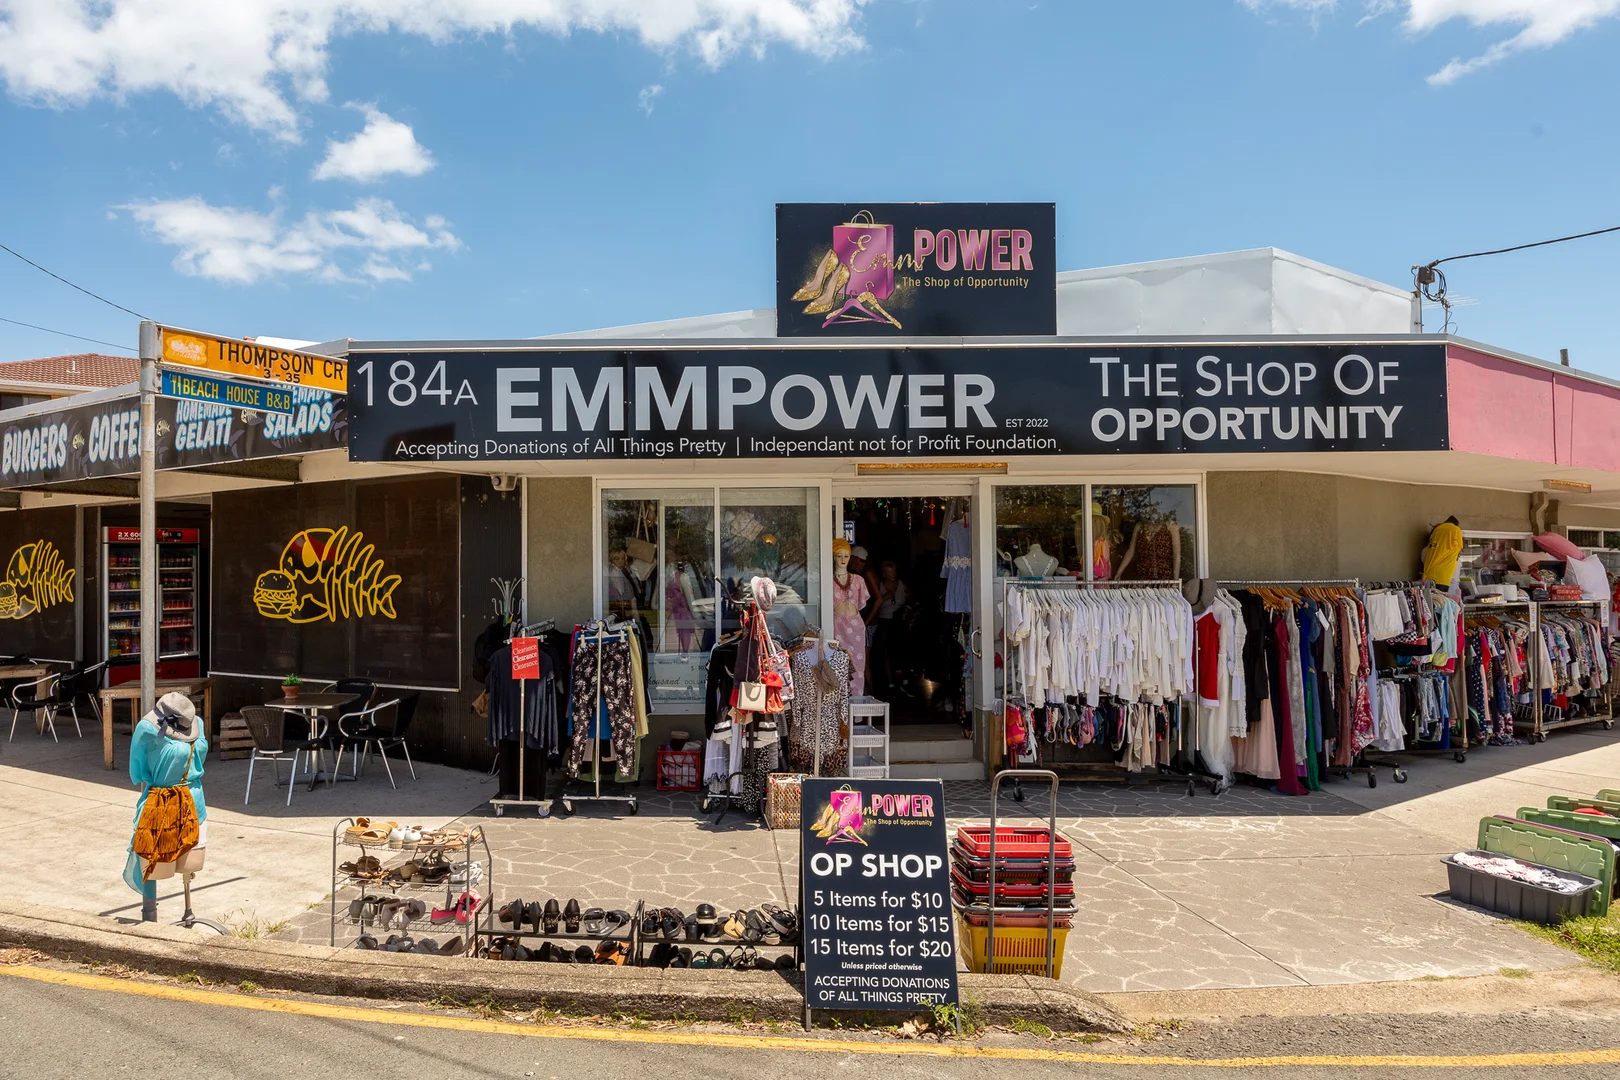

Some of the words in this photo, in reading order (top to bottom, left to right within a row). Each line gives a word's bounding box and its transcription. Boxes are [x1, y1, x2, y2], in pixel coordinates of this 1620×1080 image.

[913, 229, 1033, 271] POWER
[902, 276, 920, 287] The
[924, 276, 950, 289] Shop
[953, 276, 964, 287] of
[967, 276, 1029, 289] Opportunity
[216, 340, 314, 375] THOMPSON
[322, 359, 344, 382] CR
[264, 369, 271, 379] 3
[286, 372, 300, 384] 35
[183, 378, 219, 400] BEACH
[226, 385, 261, 406] HOUSE
[267, 391, 290, 410] B&B
[357, 360, 478, 407] 184A
[496, 365, 997, 432] EMMPOWER
[263, 400, 334, 440] SALADS
[1005, 418, 1024, 428] EST
[1026, 418, 1048, 428] 2022
[1091, 405, 1403, 442] OPPORTUNITY
[88, 411, 141, 464] COFFE
[175, 417, 233, 451] GELATI
[1, 422, 68, 476] BURGERS
[396, 441, 479, 459] Accepting
[485, 439, 567, 457] Donations
[573, 438, 590, 453] of
[594, 438, 615, 453] All
[621, 438, 674, 456] Things
[680, 437, 726, 455] Pretty
[750, 436, 854, 456] Independant
[860, 437, 886, 450] not
[890, 435, 913, 450] for
[918, 435, 961, 450] Profit
[965, 434, 1057, 450] Foundation
[648, 676, 681, 686] housand
[871, 794, 935, 817] POWER
[878, 818, 892, 826] Shop
[900, 818, 933, 827] Opportunity
[810, 853, 853, 877] OP
[862, 853, 943, 878] SHOP
[813, 890, 824, 906] 5
[830, 891, 877, 907] Items
[881, 891, 906, 908] for
[911, 891, 943, 910] $10
[810, 915, 830, 931] 10
[836, 915, 883, 932] Items
[887, 915, 913, 932] for
[918, 916, 950, 933] $15
[810, 939, 831, 955] 15
[837, 939, 884, 956] Items
[889, 939, 914, 957] for
[919, 940, 952, 958] $20
[841, 962, 864, 970] Unless
[865, 962, 887, 972] priced
[888, 963, 923, 971] otherwise
[814, 975, 879, 988] ACCEPTING
[882, 976, 950, 989] DONATIONS
[819, 990, 835, 1001] OF
[838, 990, 859, 1002] ALL
[861, 991, 903, 1003] THINGS
[906, 992, 947, 1004] PRETTY
